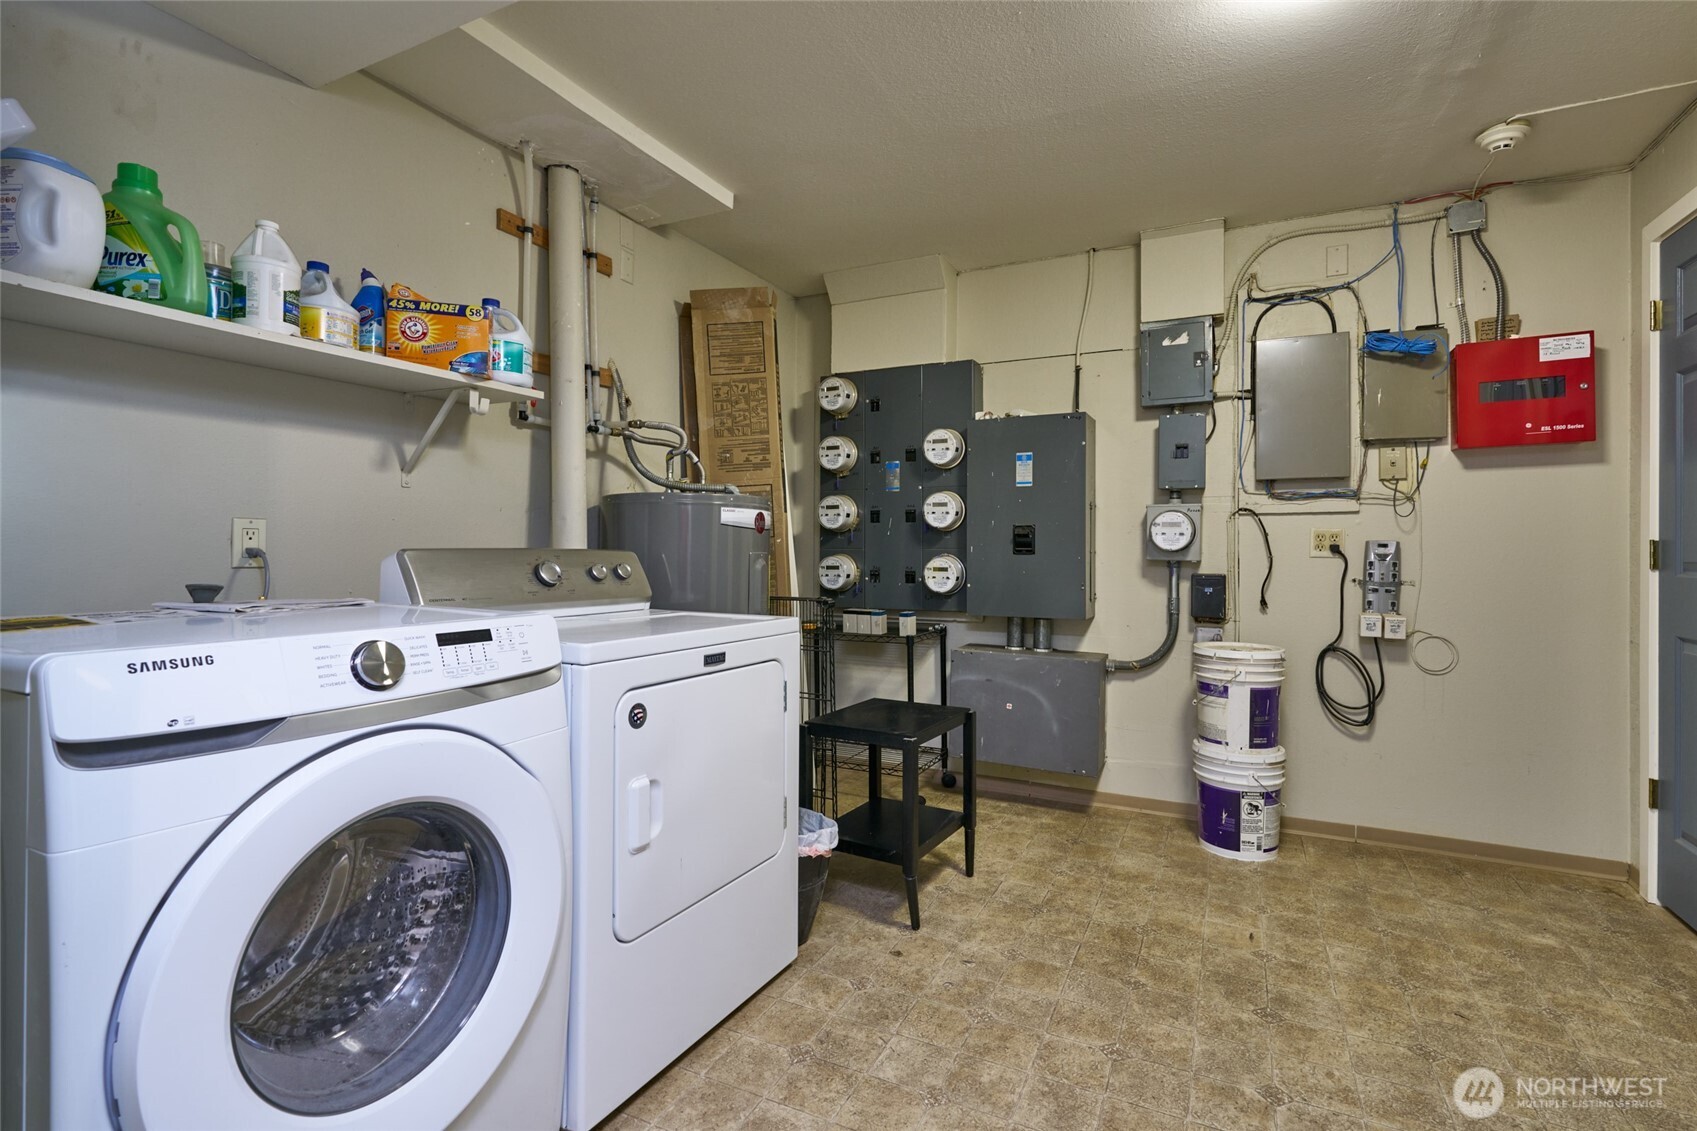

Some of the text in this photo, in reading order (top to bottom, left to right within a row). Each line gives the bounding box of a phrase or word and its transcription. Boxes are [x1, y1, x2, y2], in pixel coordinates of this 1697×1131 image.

[389, 299, 416, 309] 45%
[419, 302, 460, 314] MORE!
[468, 307, 482, 317] 58
[127, 655, 215, 674] SAMSUNG
